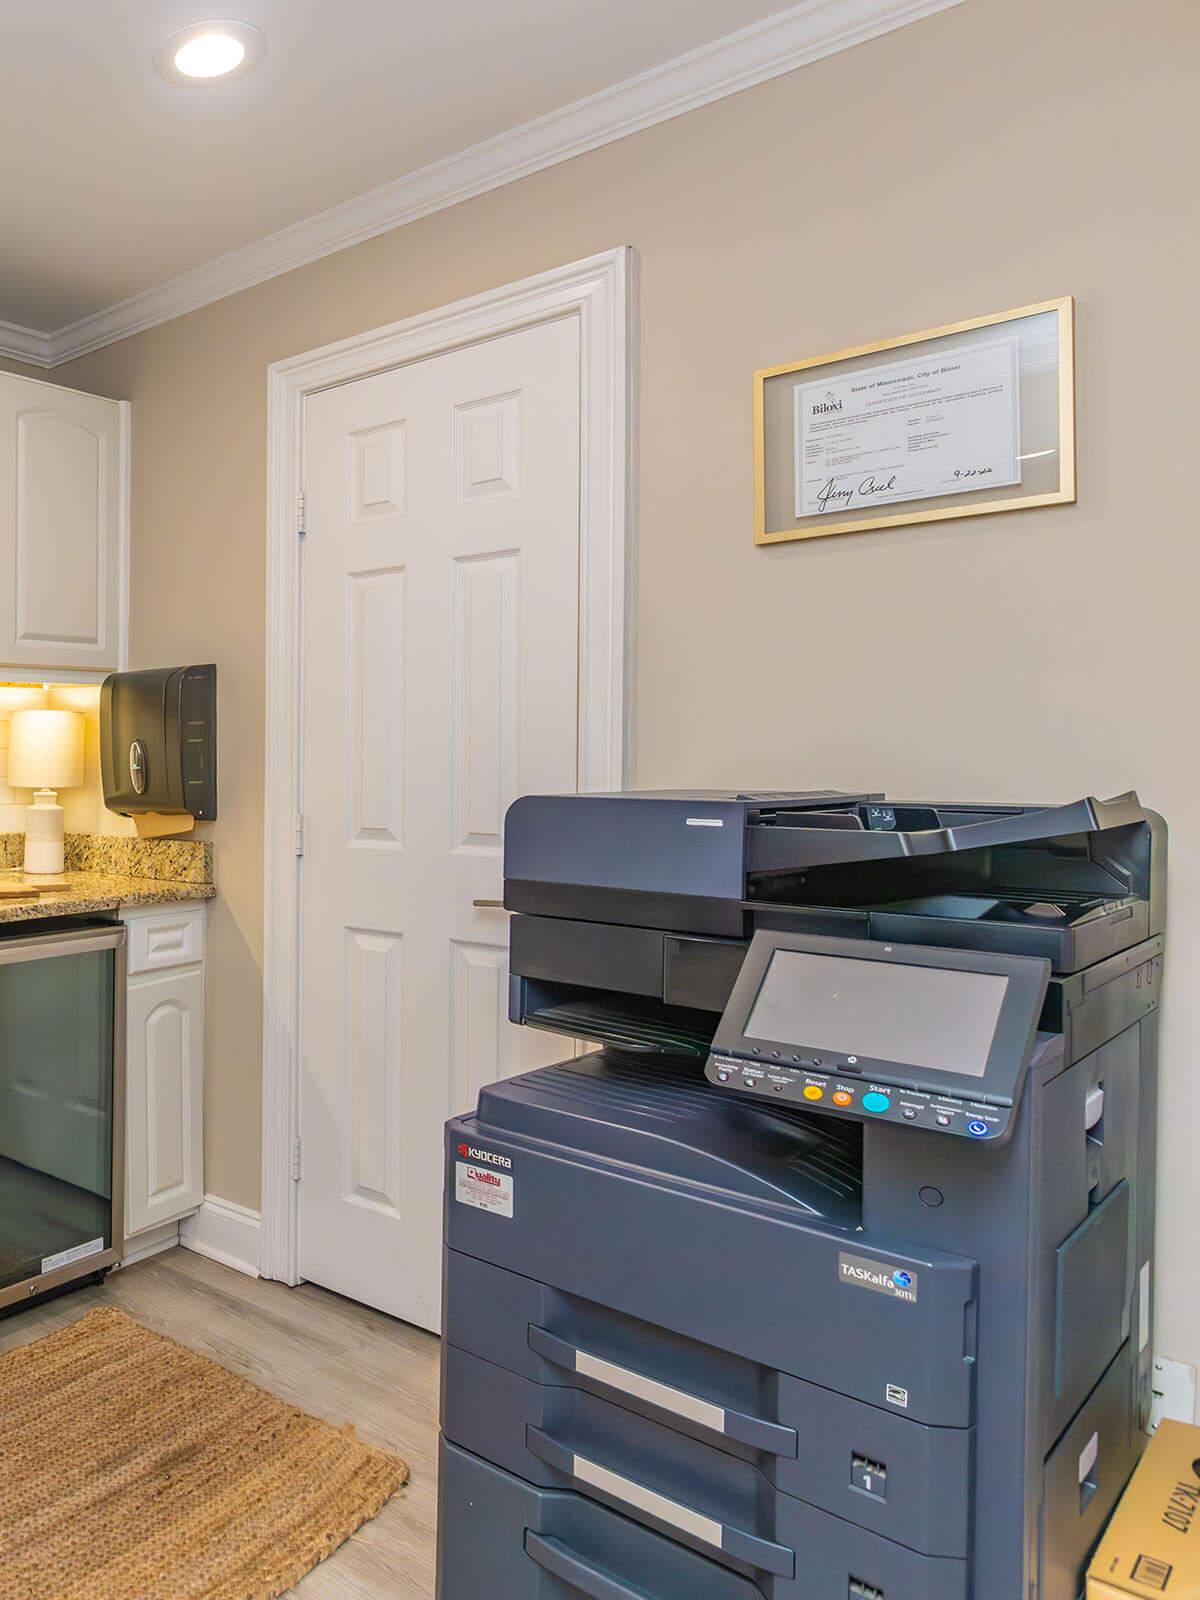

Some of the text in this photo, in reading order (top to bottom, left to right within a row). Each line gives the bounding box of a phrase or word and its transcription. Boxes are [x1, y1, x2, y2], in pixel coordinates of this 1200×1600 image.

[850, 385, 867, 393] State
[917, 371, 931, 379] City
[812, 399, 843, 415] Biloxi
[805, 1078, 826, 1088] Reset
[836, 1084, 855, 1093] Stop
[869, 1084, 891, 1094] Start
[468, 1147, 512, 1168] KYOCERA
[467, 1166, 501, 1187] Quality
[841, 1263, 895, 1288] TASKalfa
[862, 1474, 872, 1490] 1
